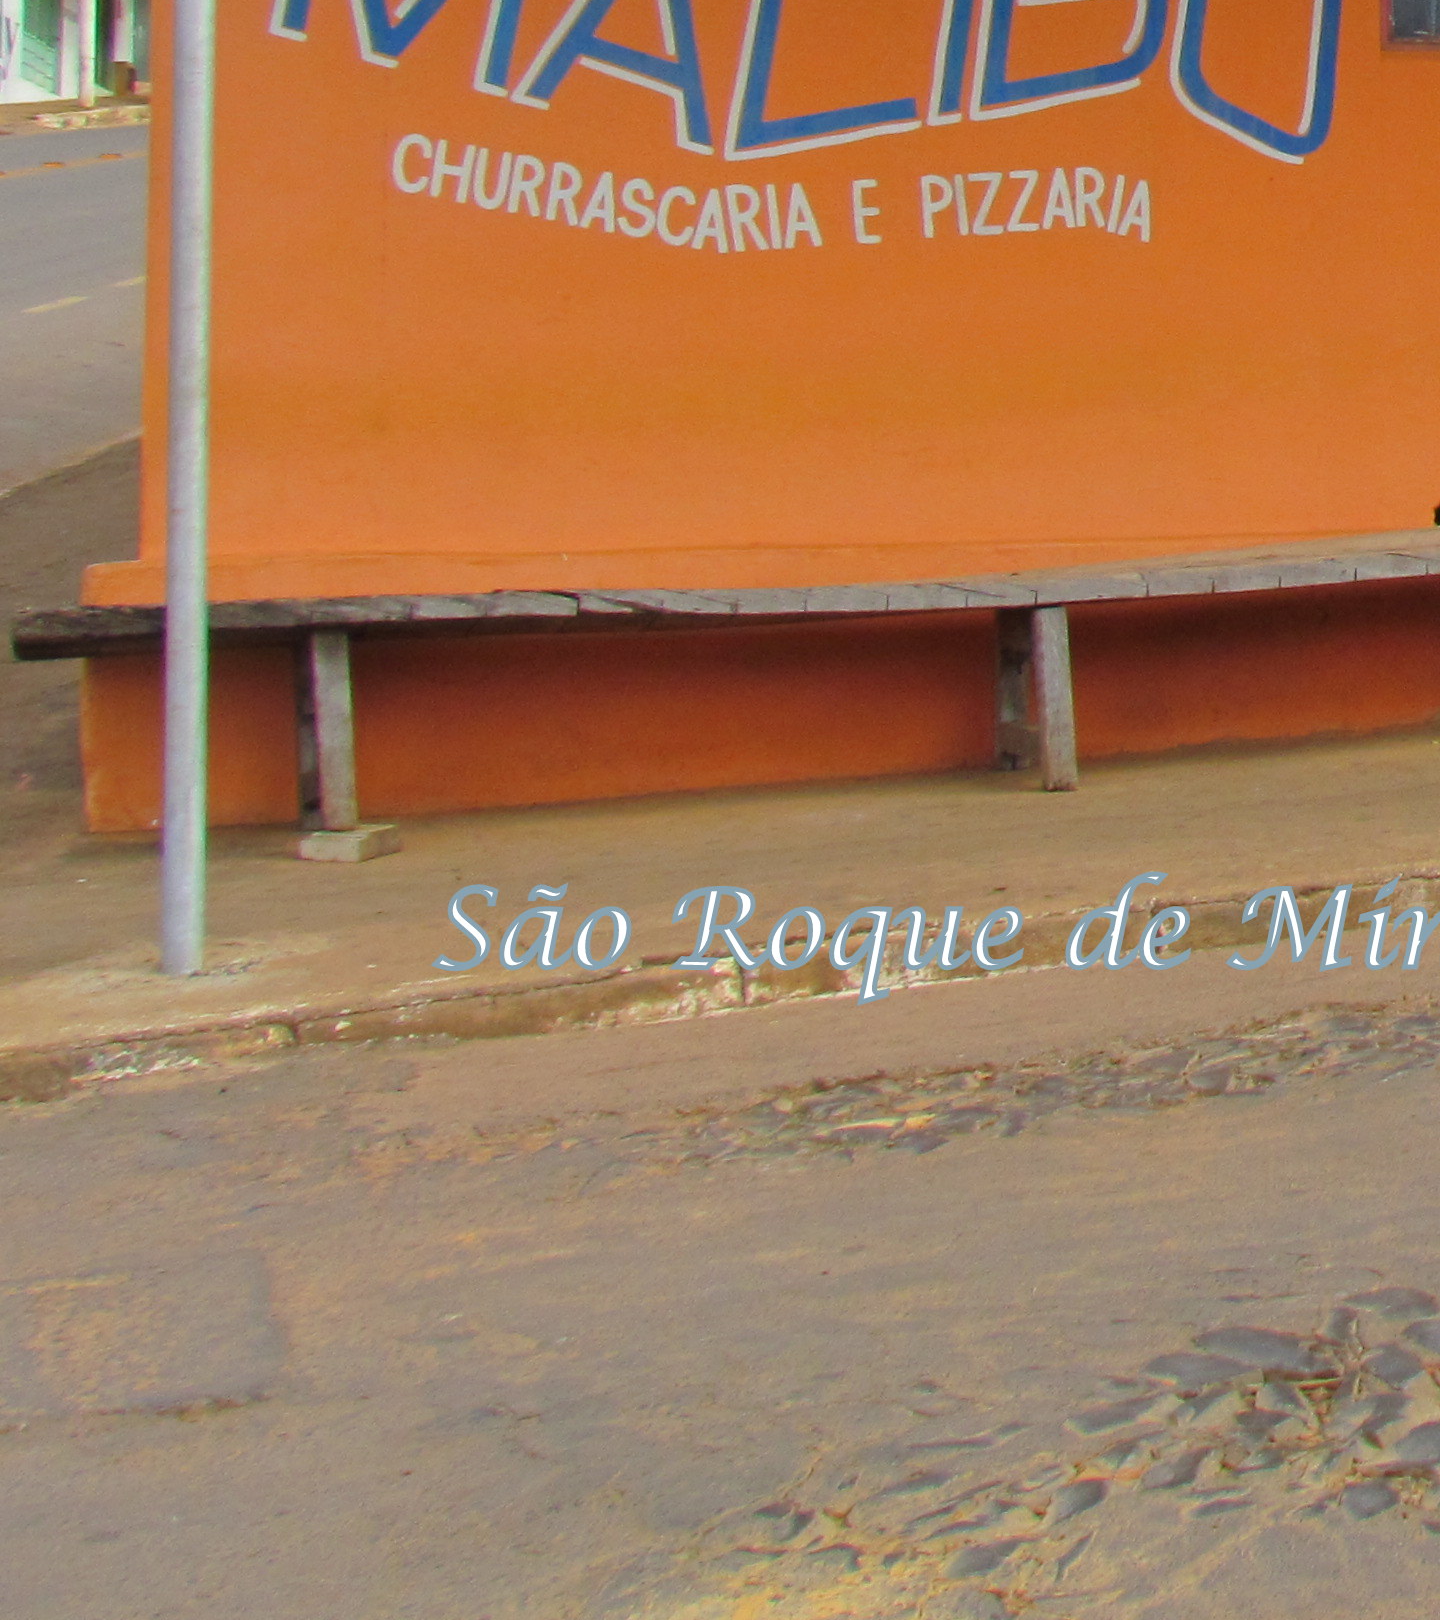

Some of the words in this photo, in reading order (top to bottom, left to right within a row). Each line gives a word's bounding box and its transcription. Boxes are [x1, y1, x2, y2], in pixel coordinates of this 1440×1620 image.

[390, 132, 823, 254] CHURRASCARIA
[852, 178, 883, 244] E
[920, 165, 1150, 243] PIZZARIA
